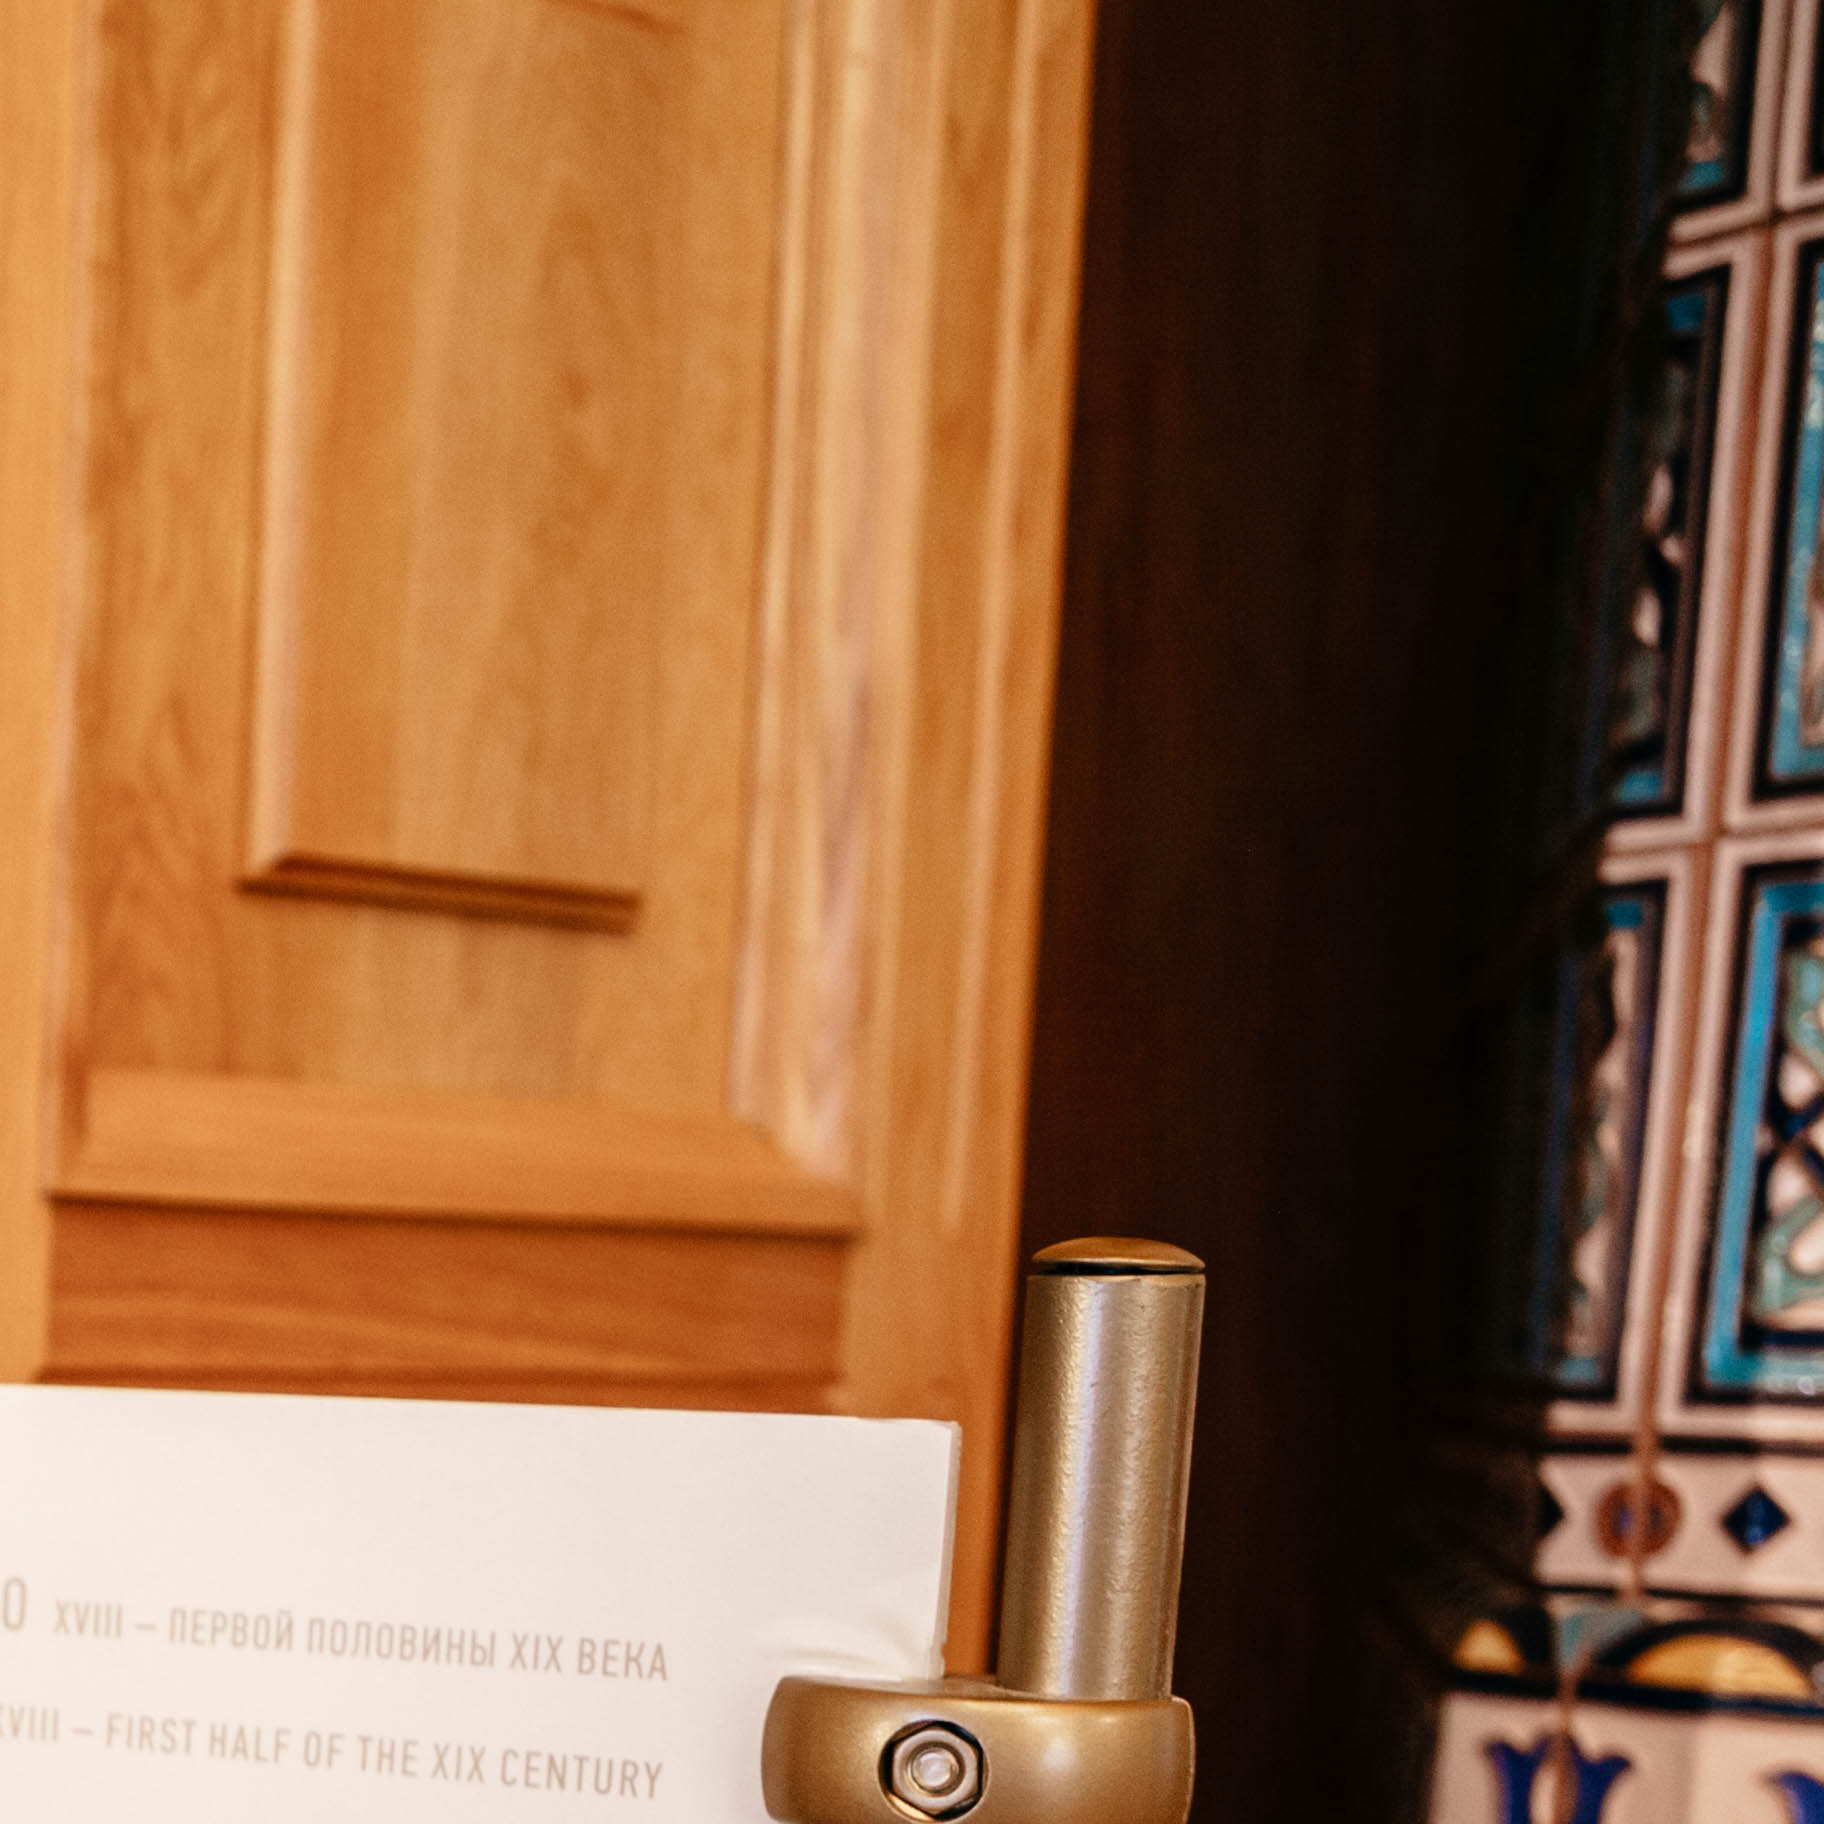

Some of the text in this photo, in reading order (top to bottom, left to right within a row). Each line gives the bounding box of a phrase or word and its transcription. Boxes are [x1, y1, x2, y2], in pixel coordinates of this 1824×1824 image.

[55, 1597, 123, 1639] XVIII
[169, 1607, 294, 1653] ПЕРВОЙ
[307, 1617, 495, 1669] ПОЛОВИНЫ
[509, 1632, 563, 1673] XIX
[577, 1638, 668, 1680] ВЕКА
[106, 1713, 196, 1756] FIRST
[210, 1723, 290, 1765] HALF
[303, 1731, 344, 1769] OF
[358, 1735, 418, 1778] THE
[431, 1742, 487, 1784] XIX
[500, 1749, 663, 1799] CENTURY
